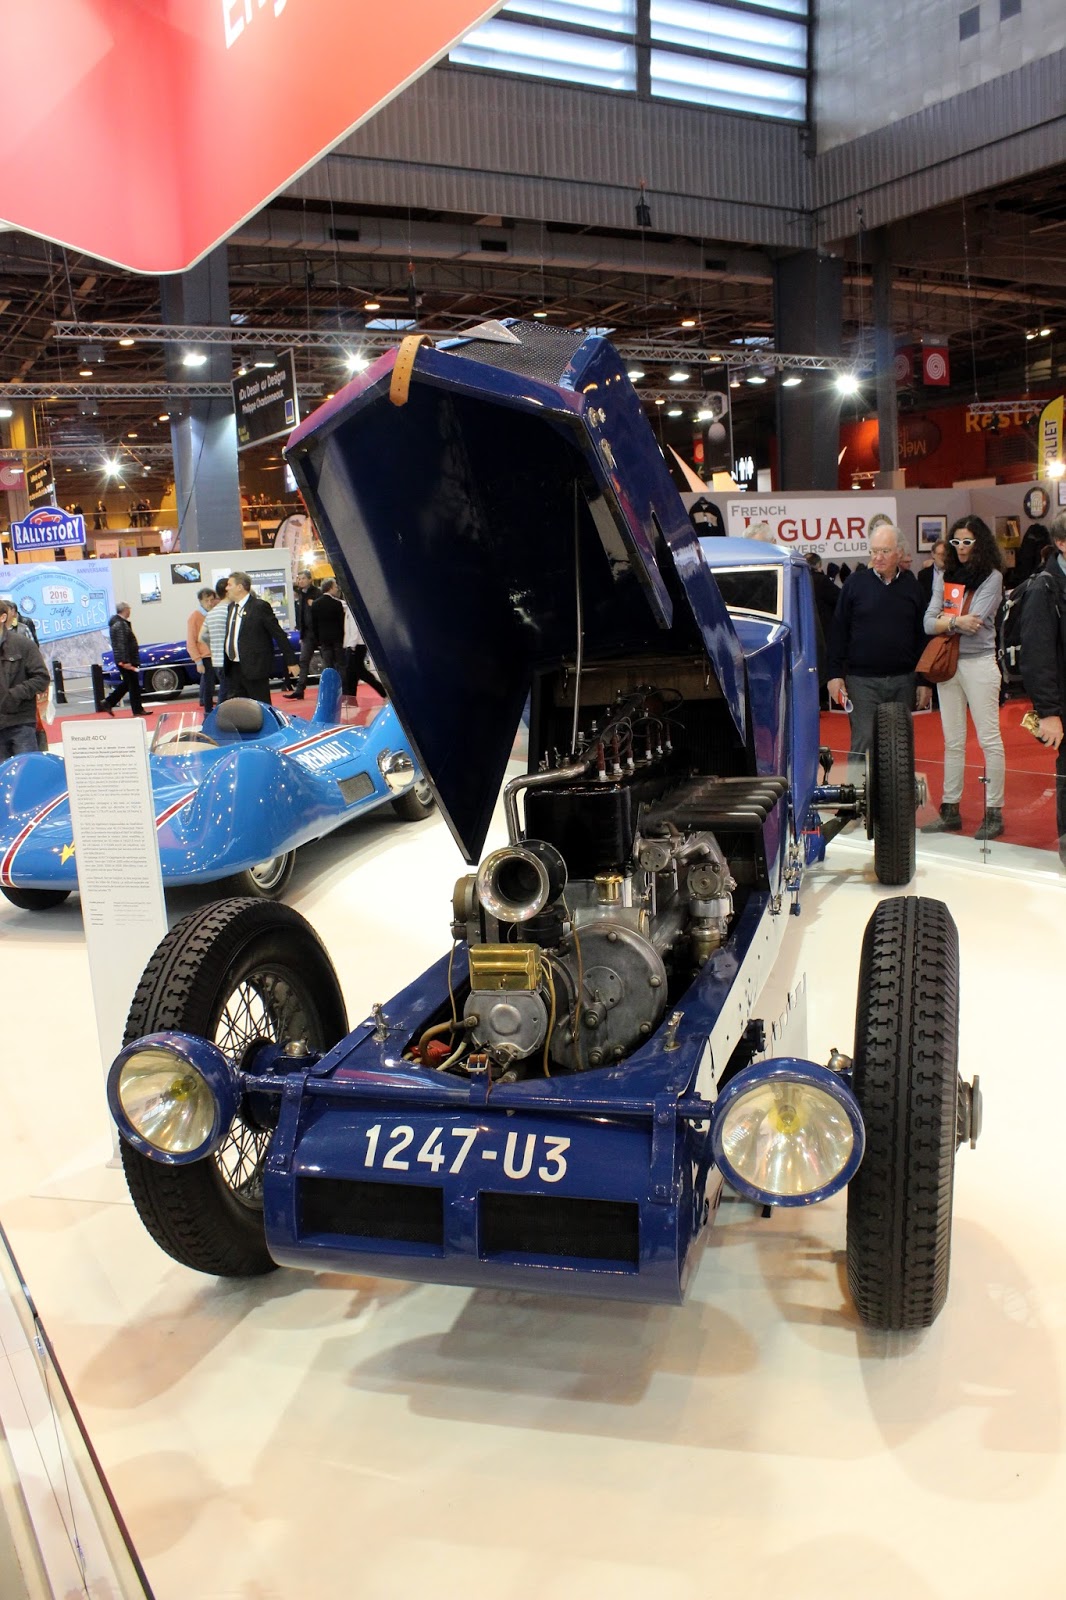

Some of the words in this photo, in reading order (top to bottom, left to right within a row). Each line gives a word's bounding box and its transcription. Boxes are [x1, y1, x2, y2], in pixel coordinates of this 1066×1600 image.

[732, 506, 786, 516] FRENCH
[14, 518, 80, 544] RALLYSTORY
[834, 542, 868, 552] CLUB
[50, 591, 68, 600] 2016
[54, 619, 72, 632] DES
[76, 601, 106, 628] ALPES
[297, 740, 350, 770] RENAULT
[364, 1124, 571, 1183] 1247-U3
